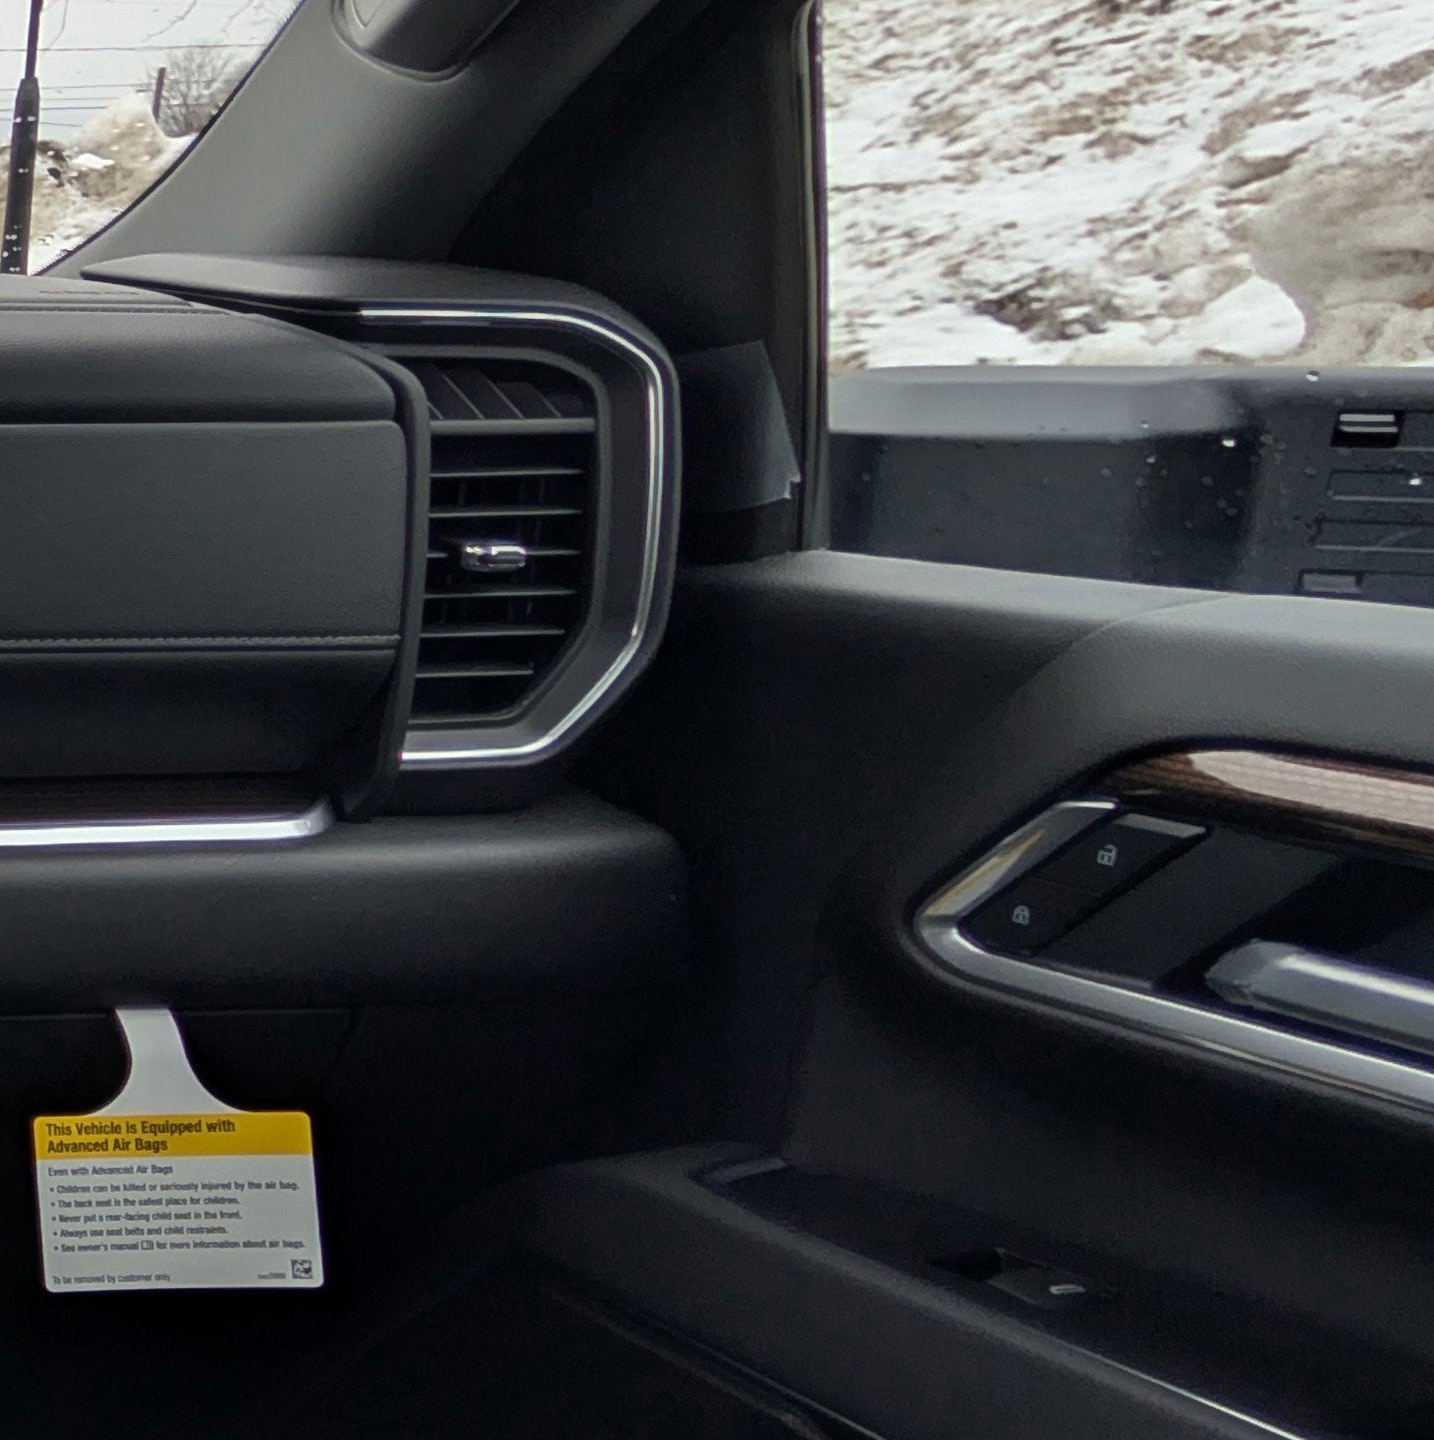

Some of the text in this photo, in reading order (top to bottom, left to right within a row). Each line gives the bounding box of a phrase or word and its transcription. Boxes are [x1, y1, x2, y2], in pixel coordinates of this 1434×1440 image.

[46, 1123, 72, 1136] This
[75, 1121, 121, 1135] Vehicle
[141, 1120, 202, 1136] Equipped
[206, 1119, 236, 1133] with
[48, 1138, 168, 1153] Advanced Air Bags
[48, 1164, 173, 1176] Even with Advanced Air Bags
[234, 1181, 245, 1191] by
